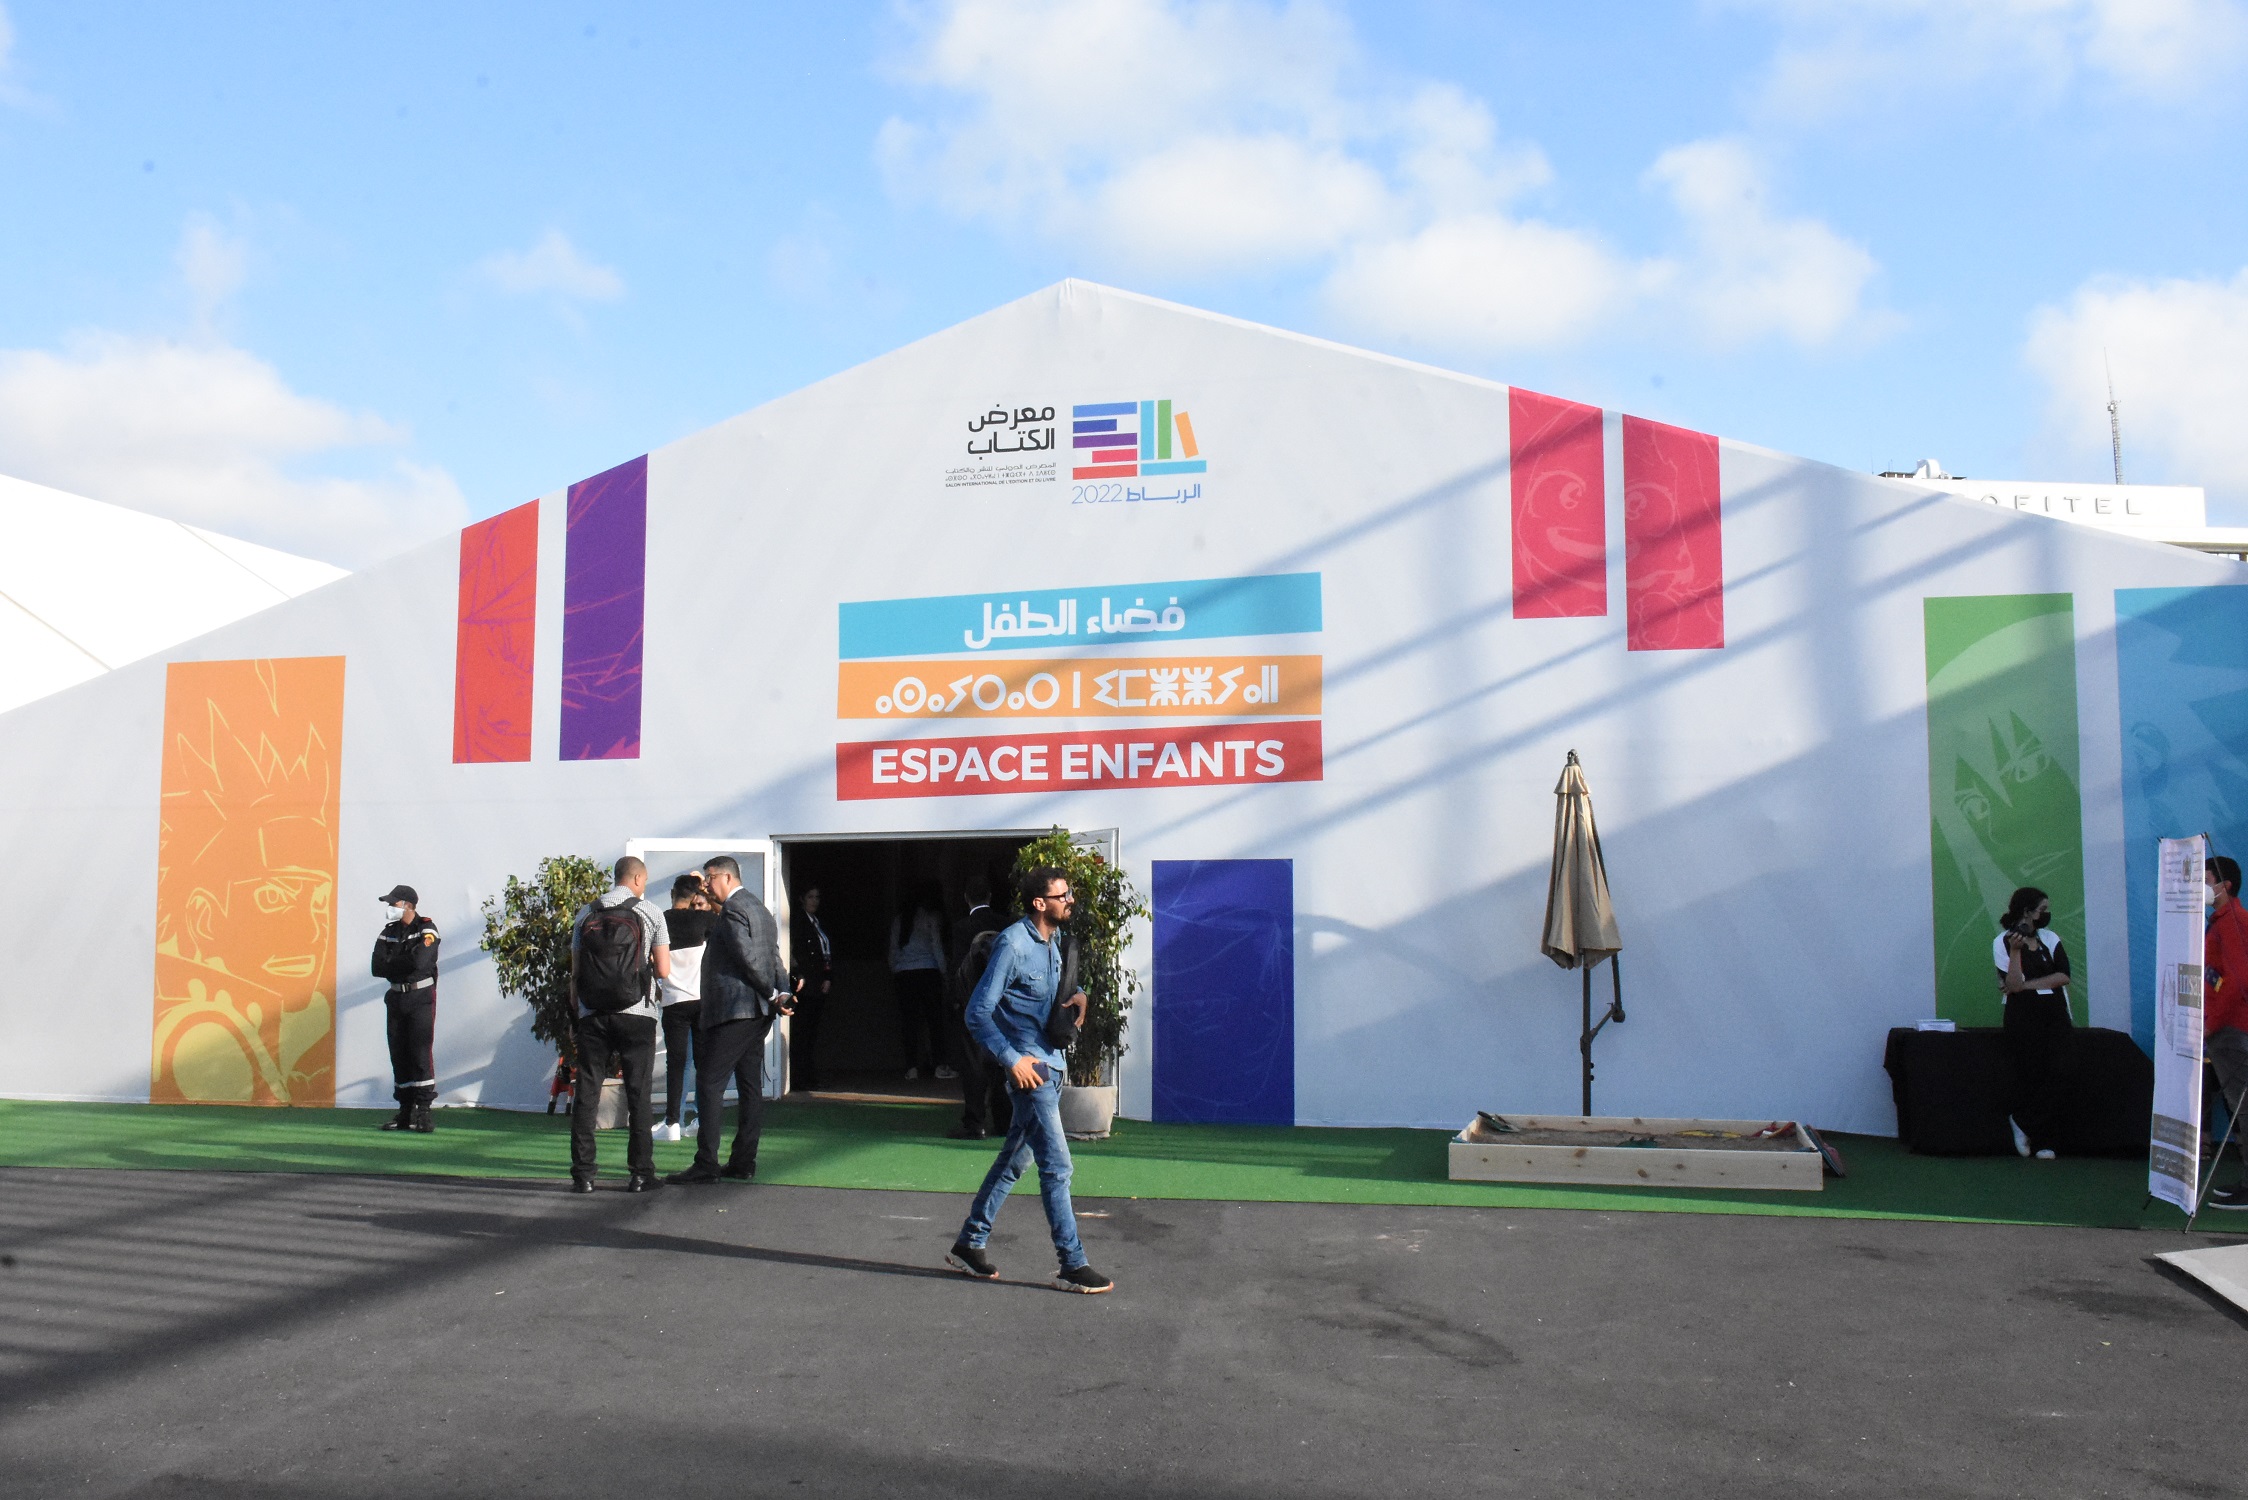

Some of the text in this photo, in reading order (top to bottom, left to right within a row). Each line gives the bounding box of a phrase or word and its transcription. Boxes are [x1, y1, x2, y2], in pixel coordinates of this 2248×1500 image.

[968, 403, 1056, 433] معرض
[967, 427, 1056, 461] الكتاب
[1071, 482, 1202, 505] الرباط 2022
[1980, 492, 2143, 516] OFITEL
[964, 596, 1186, 650] فضاء الطفل
[872, 739, 1285, 784] ESPACE ENFANTS
